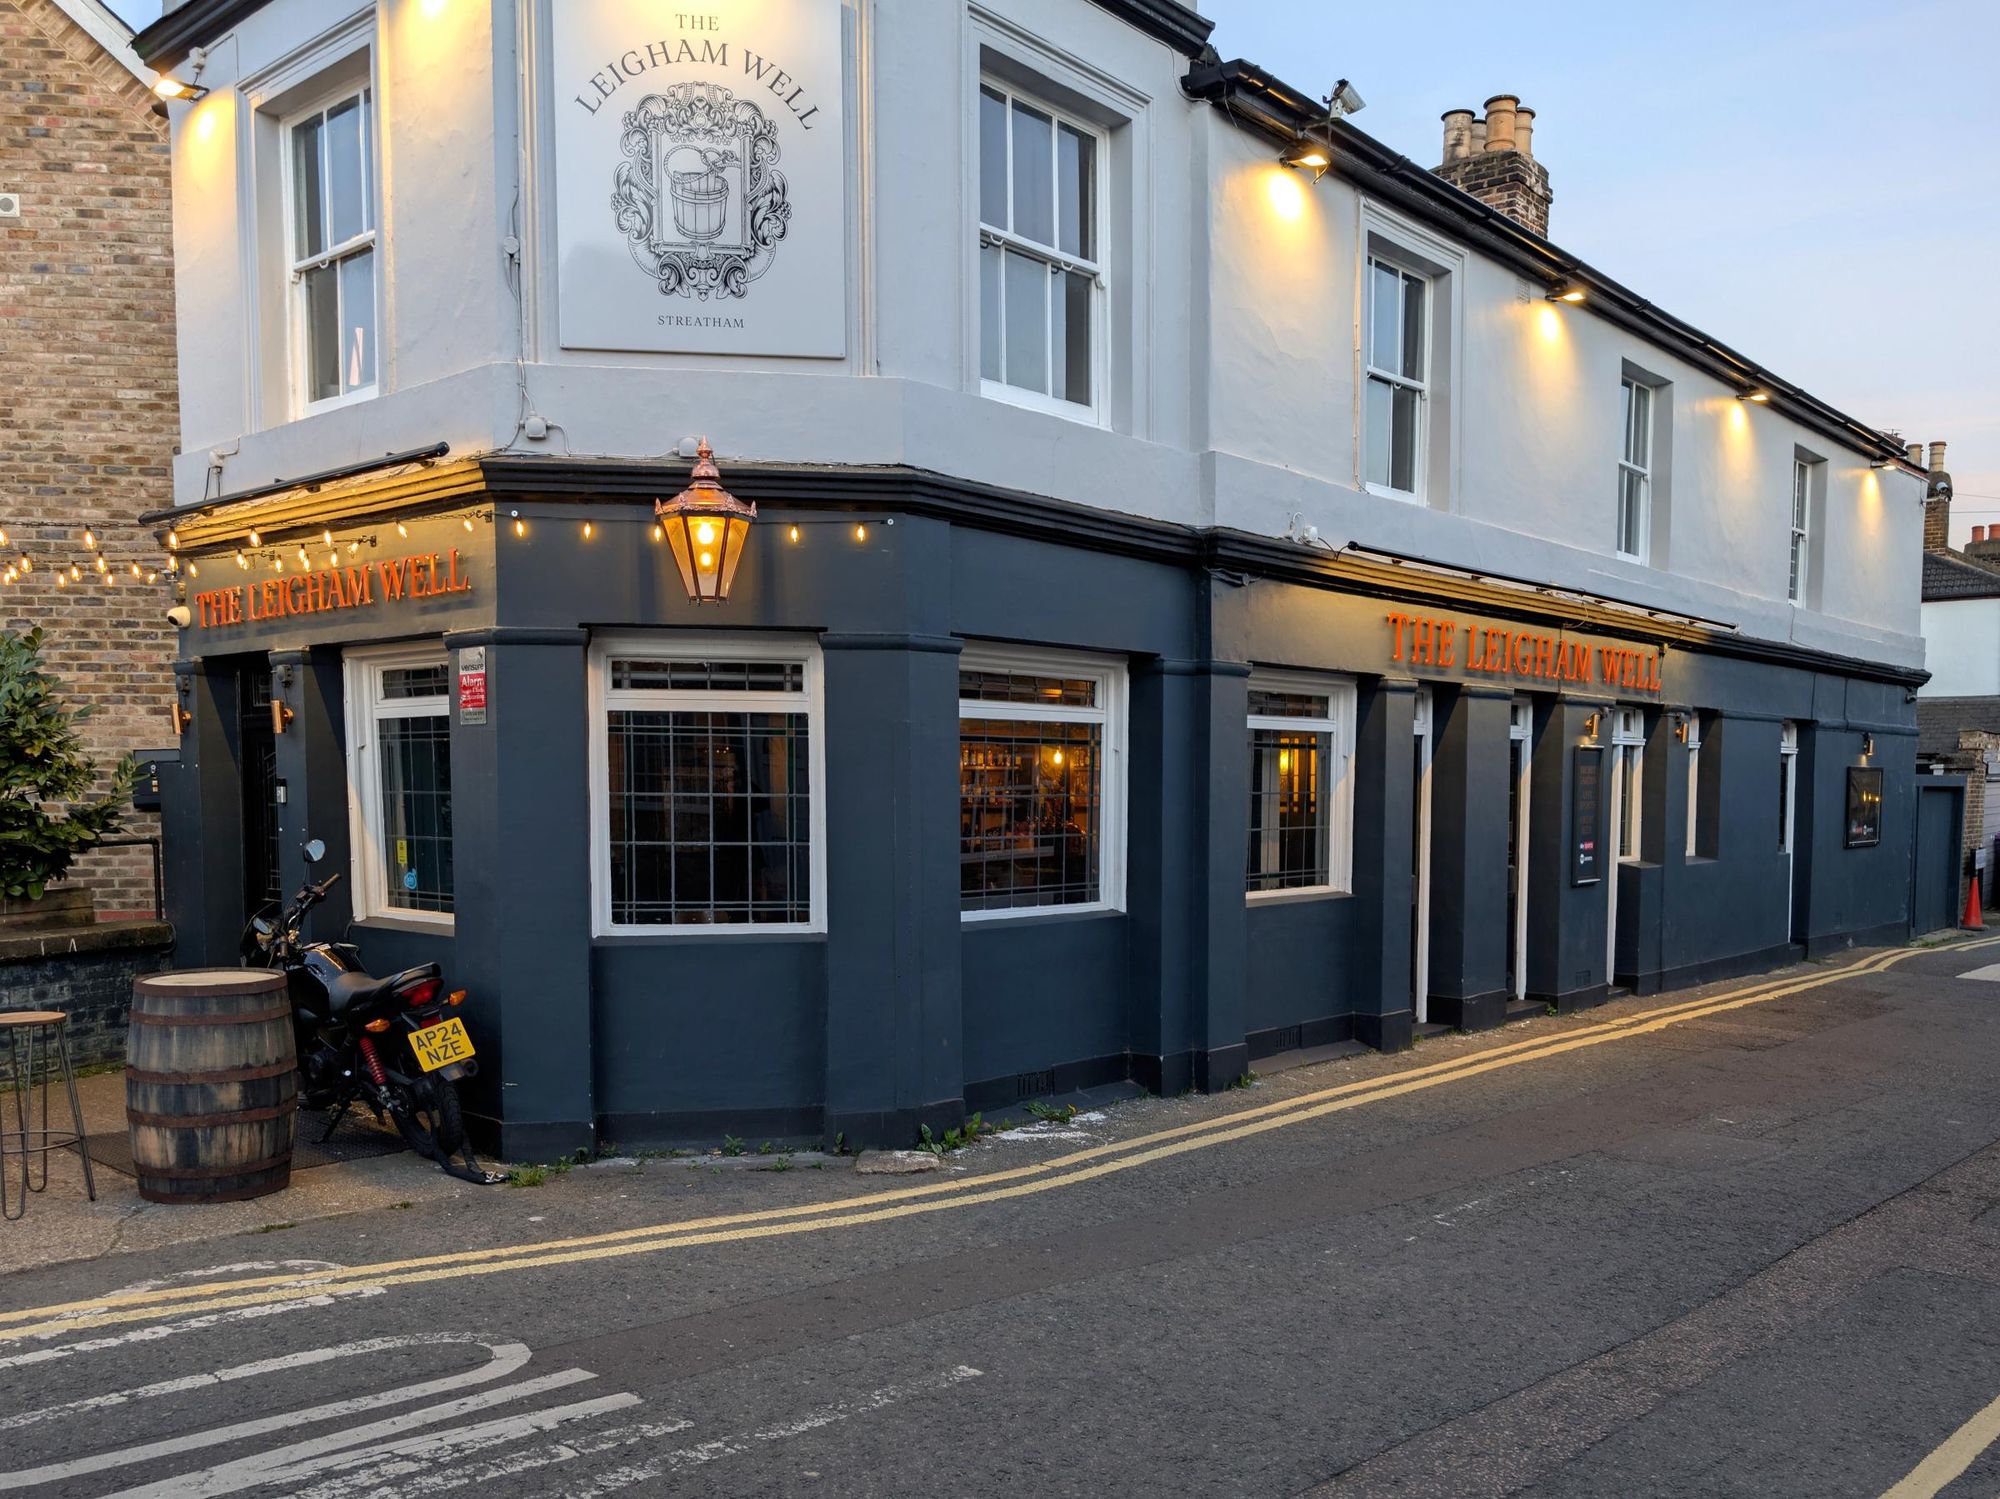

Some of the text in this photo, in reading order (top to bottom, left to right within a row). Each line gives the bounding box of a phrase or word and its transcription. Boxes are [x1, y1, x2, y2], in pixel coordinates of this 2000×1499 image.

[675, 13, 720, 31] THE
[574, 39, 821, 131] LEIGHAM WELL
[657, 315, 745, 329] STREATHAM
[194, 548, 470, 628] THE LEIGHAM WELL
[1387, 611, 1663, 692] THE LEIGHAM WELL
[416, 1023, 462, 1051] AP24
[426, 1040, 465, 1065] NZE
